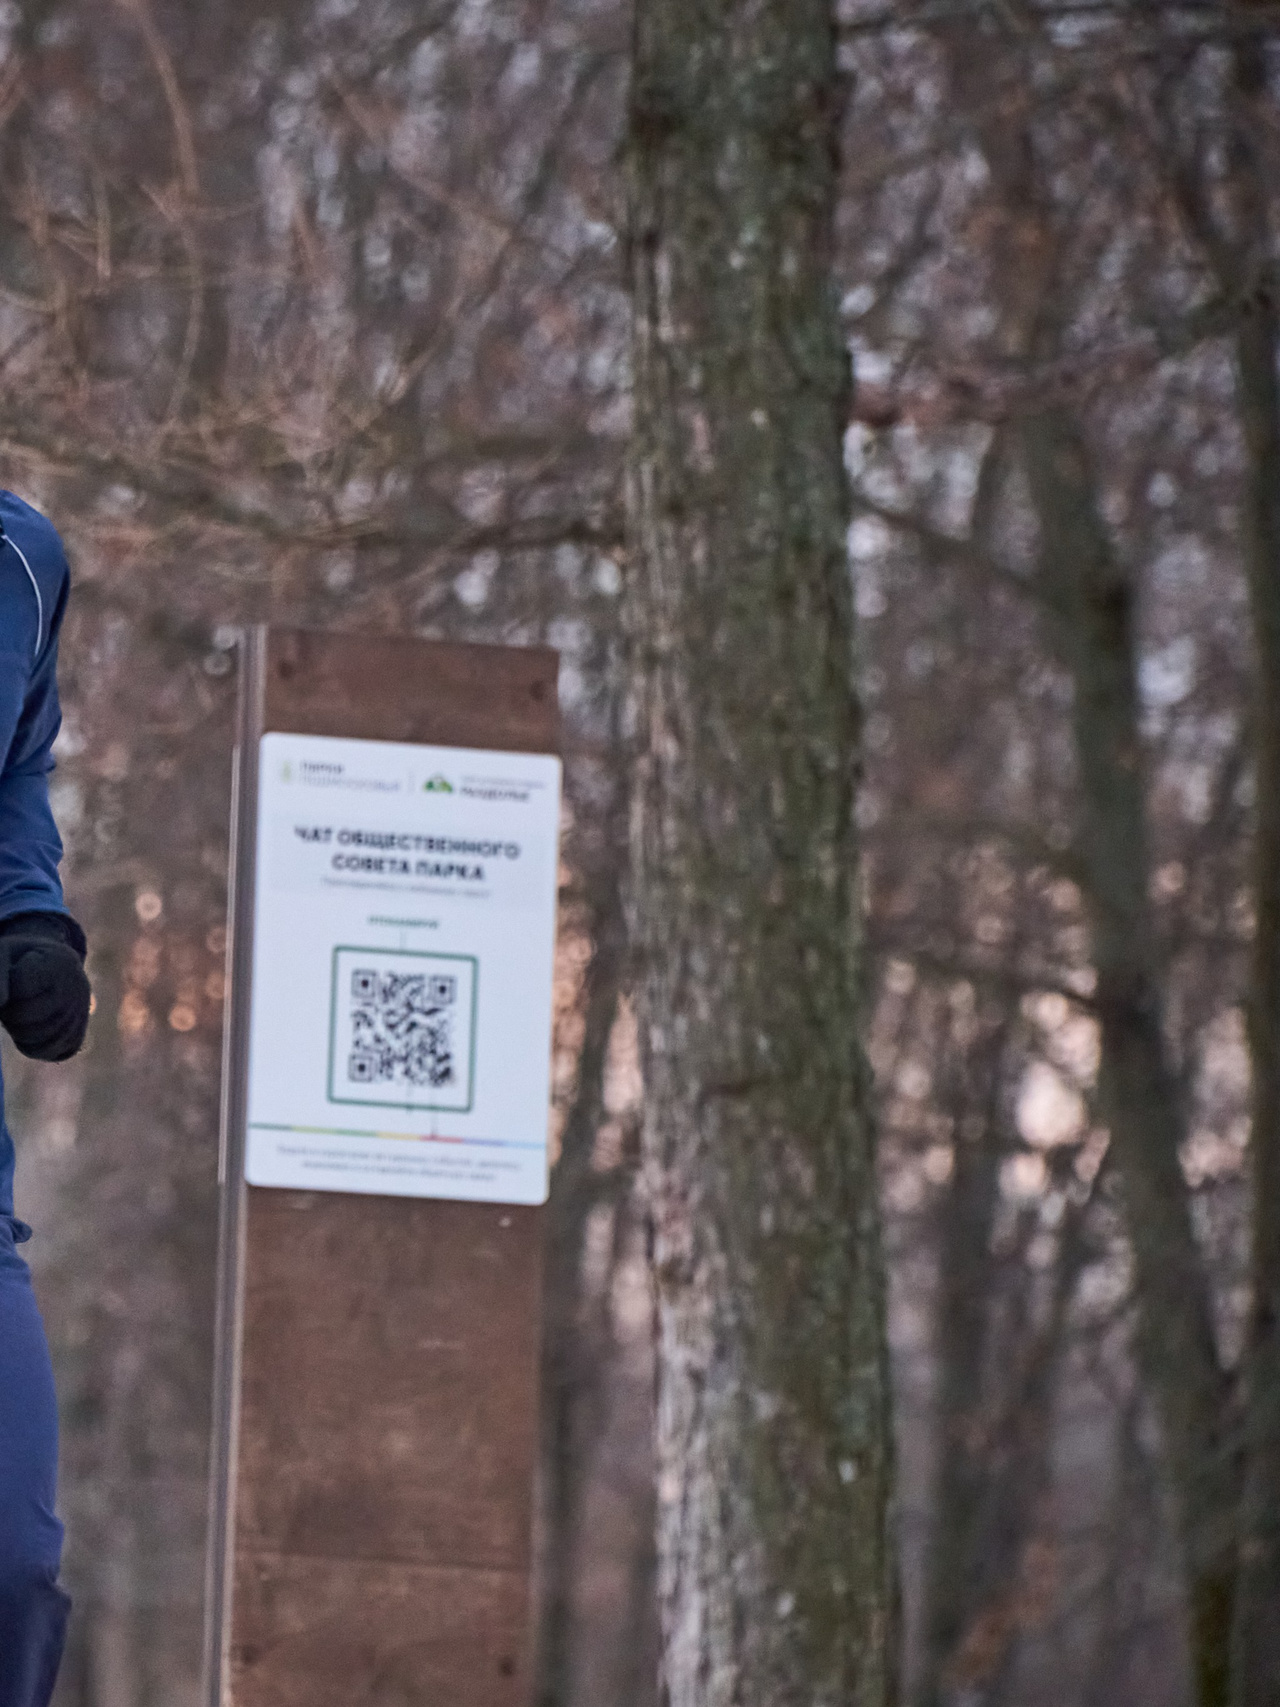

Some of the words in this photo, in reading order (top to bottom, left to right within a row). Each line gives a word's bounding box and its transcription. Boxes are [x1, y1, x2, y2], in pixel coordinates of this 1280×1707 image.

[294, 825, 332, 843] ЧАТ
[337, 829, 521, 860] ОБЩЕСТВЕННОГО
[331, 853, 410, 876] СОВЕТА
[415, 861, 485, 881] ПАРКА
